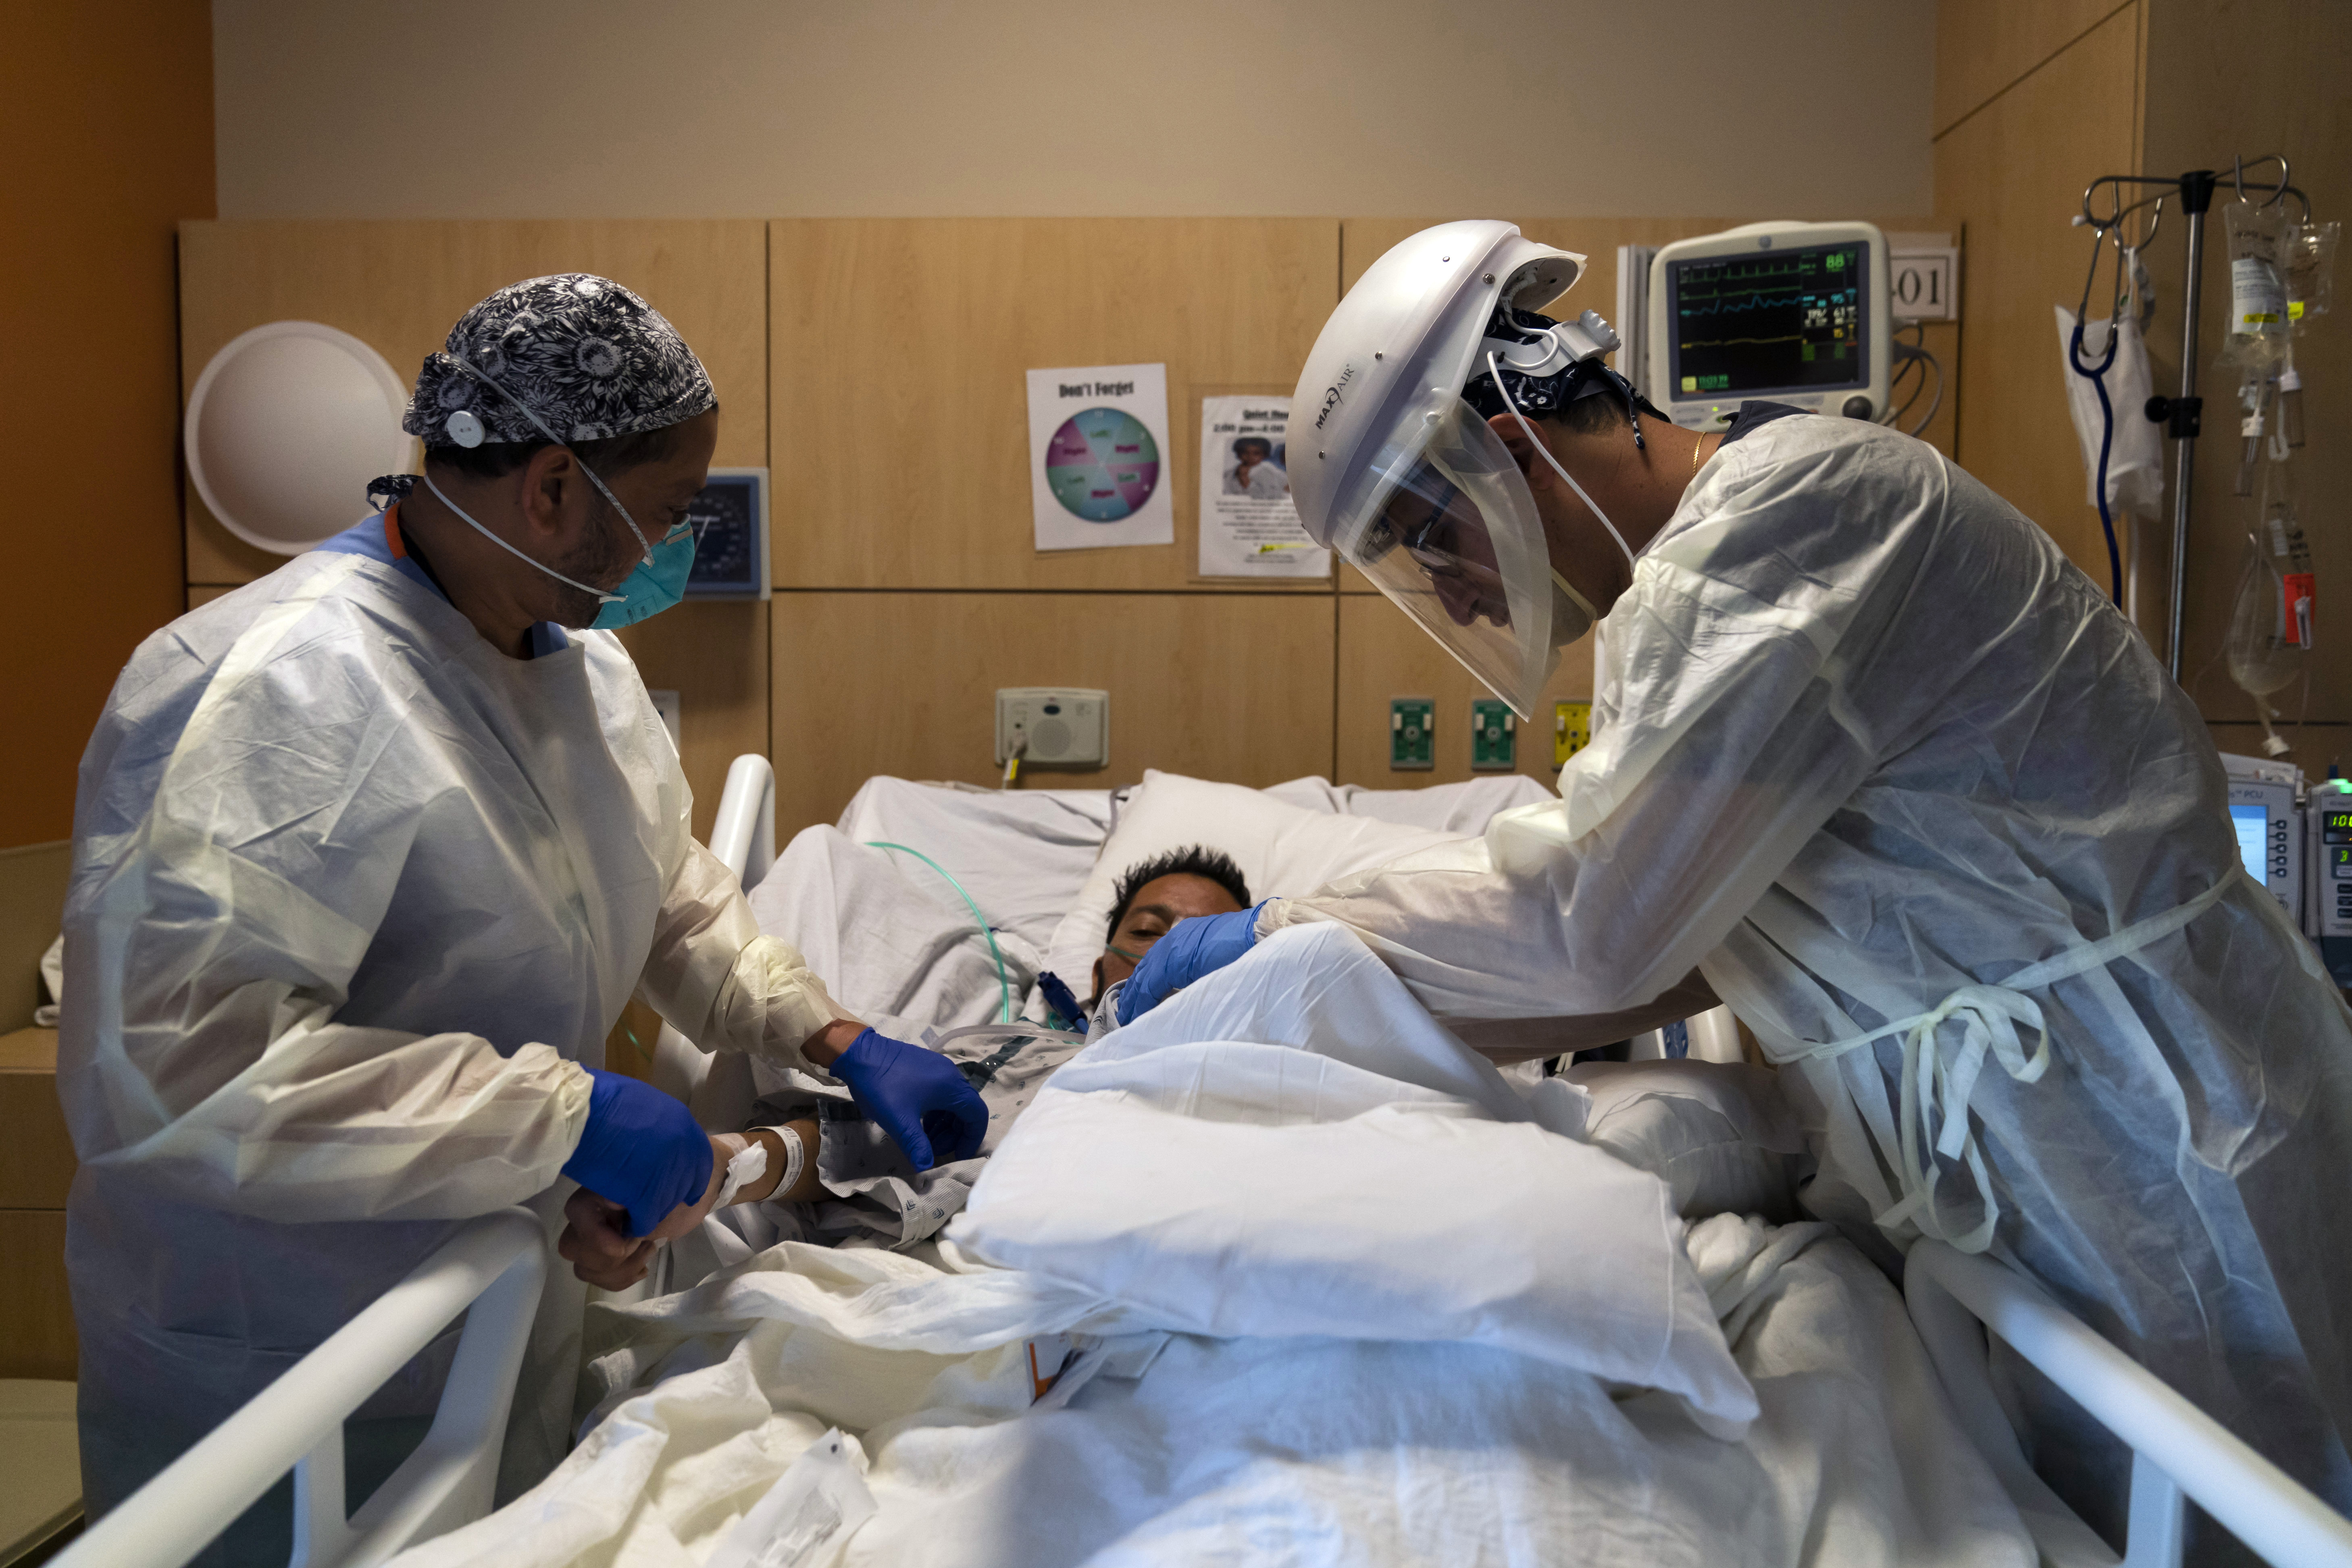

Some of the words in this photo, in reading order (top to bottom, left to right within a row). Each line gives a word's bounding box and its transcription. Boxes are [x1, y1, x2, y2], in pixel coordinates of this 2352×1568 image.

[1059, 383, 1091, 398] Don't
[1095, 381, 1134, 397] Forget
[1315, 390, 1339, 429] MAX
[1337, 368, 1355, 392] AIR
